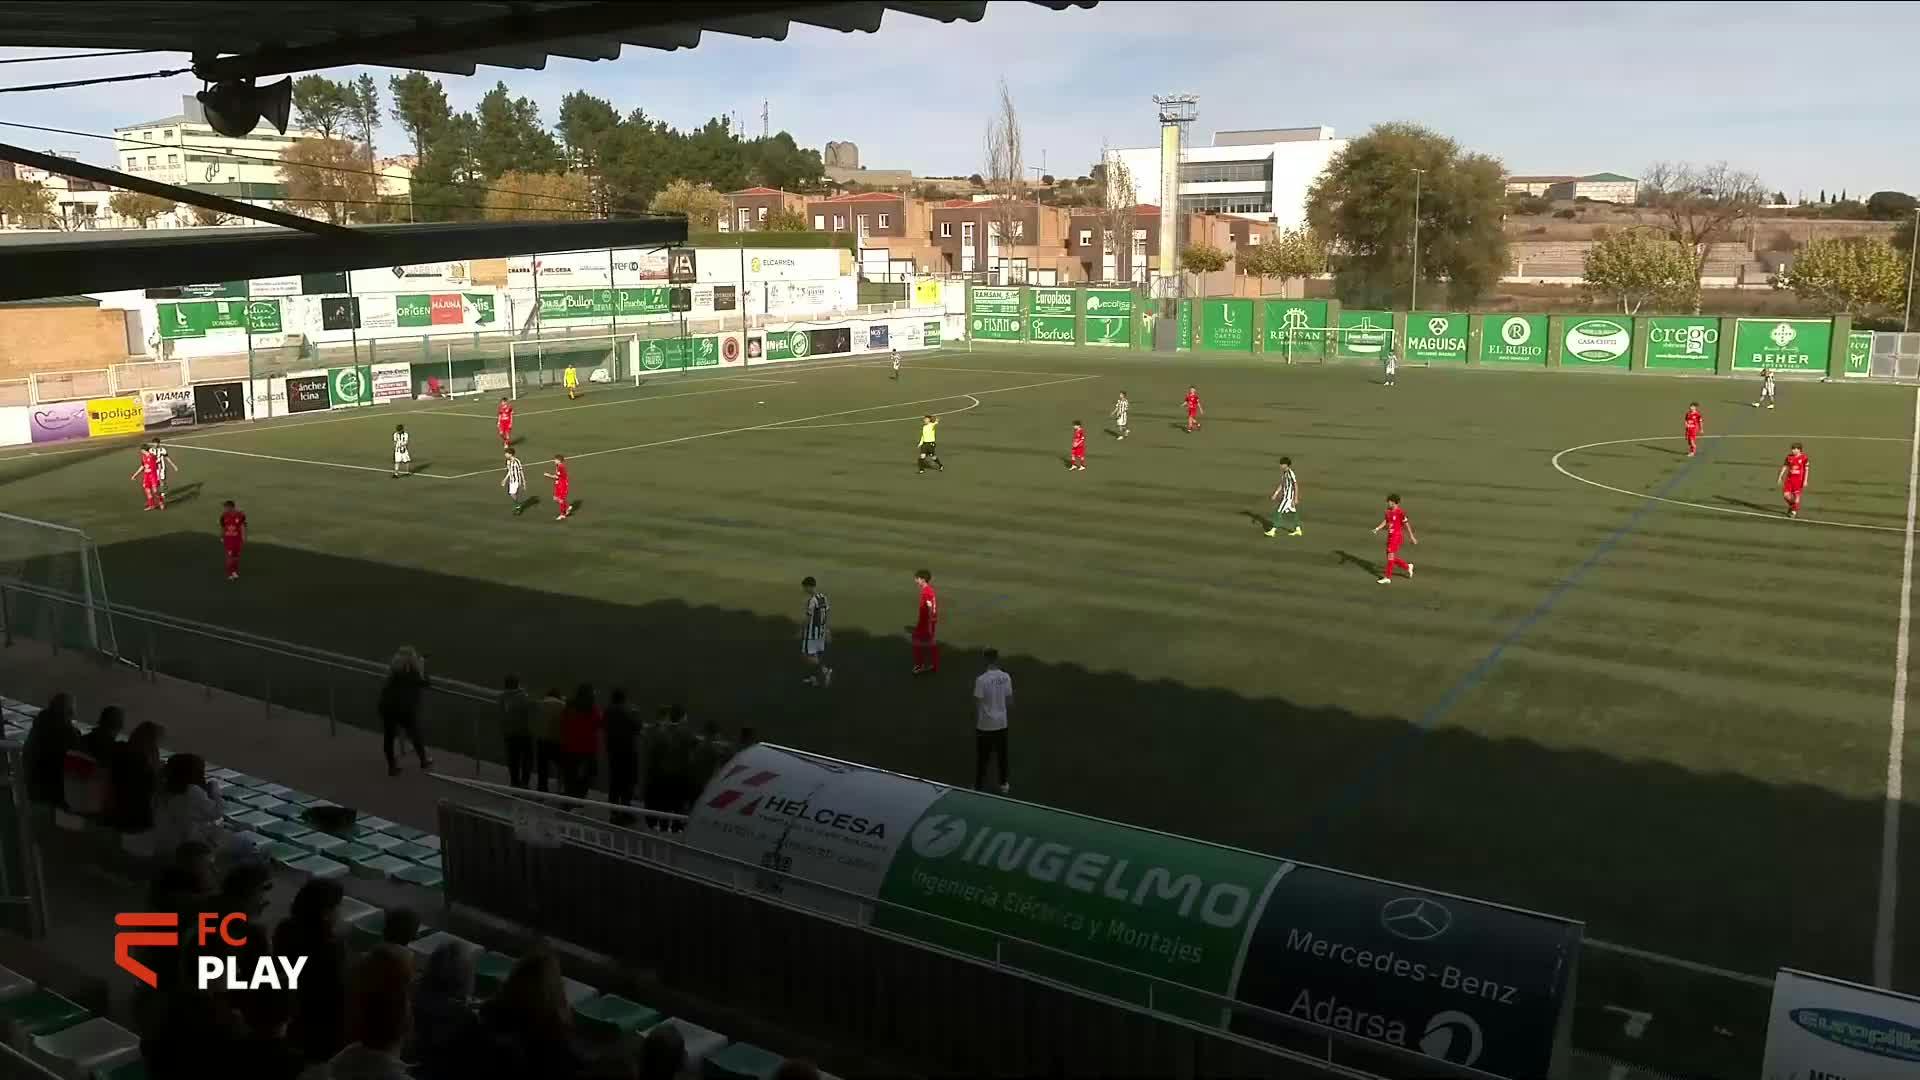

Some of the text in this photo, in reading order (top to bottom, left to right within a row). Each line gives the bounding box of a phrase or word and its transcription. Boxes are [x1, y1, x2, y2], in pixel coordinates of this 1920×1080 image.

[1408, 336, 1466, 351] MAGUISA
[1488, 345, 1542, 356] EL RUBIO
[1752, 353, 1809, 364] BEHER
[155, 390, 191, 401] VIAMAR
[100, 407, 143, 421] poligar
[765, 795, 885, 839] HELCESA
[959, 826, 1251, 928] INGELMO
[1087, 919, 1105, 941] y
[1106, 919, 1204, 963] Montajes
[1285, 928, 1520, 1005] Mercedes-Benz
[1288, 988, 1408, 1046] Adarsa
